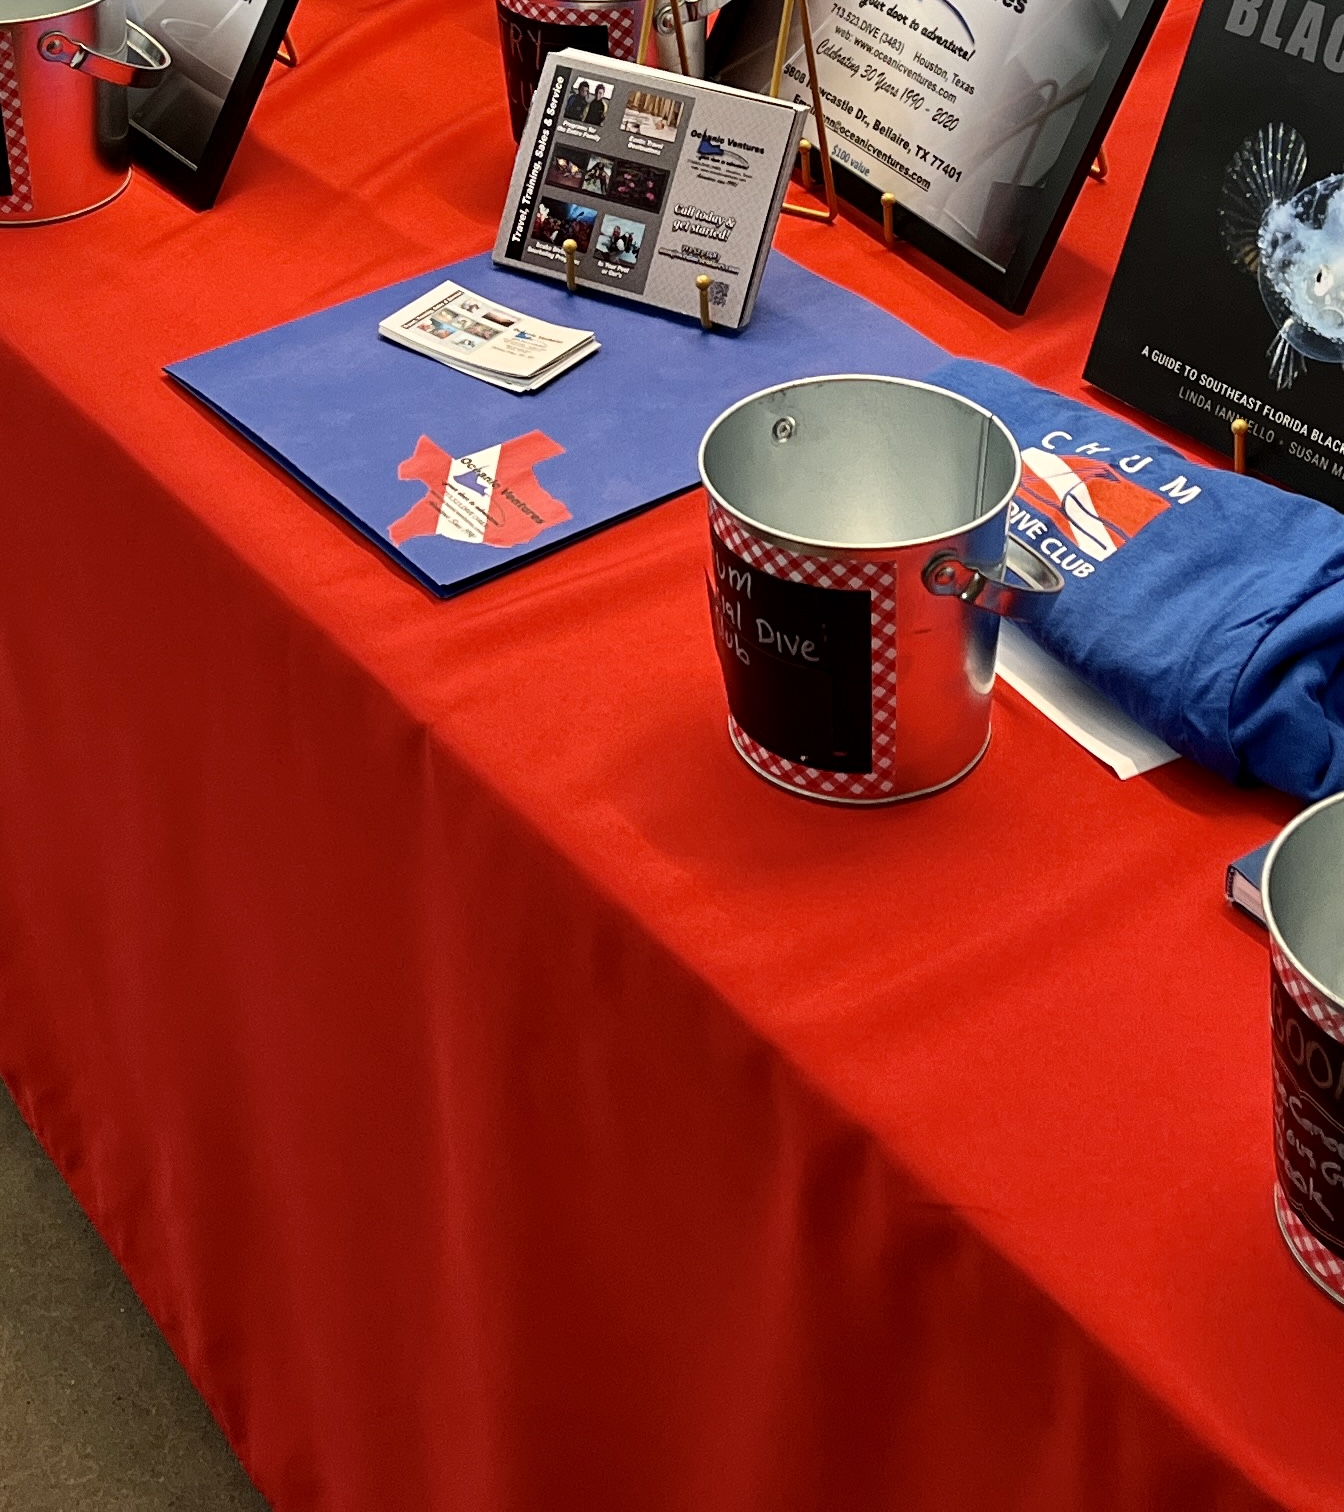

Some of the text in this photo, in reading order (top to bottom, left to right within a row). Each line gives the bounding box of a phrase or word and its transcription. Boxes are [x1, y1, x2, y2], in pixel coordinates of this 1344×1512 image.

[831, 3, 975, 96] 713.523.DIVE (3483) Houston, Texas
[909, 16, 920, 31] to
[816, 39, 960, 133] Celebrating 30 Years 1990 2020
[853, 36, 957, 104] www.oceanicventures.com
[511, 75, 565, 243] Travel, Training, Sales & Service
[783, 63, 806, 84] 5808
[806, 77, 854, 115] wcastle
[872, 118, 912, 155] Bellaire,
[914, 144, 929, 163] TX
[929, 152, 963, 183] 77401
[831, 143, 870, 177] $100 value
[672, 219, 732, 242] get started!
[674, 203, 736, 229] Call today &
[1141, 345, 1150, 357] A
[1151, 349, 1181, 373] GUIDE
[1184, 365, 1197, 381] TO
[1199, 374, 1262, 413] SOUTHEAST
[1262, 404, 1308, 436] FLORIDA
[1178, 386, 1212, 412] LINDA
[1214, 403, 1275, 443] IANELLO
[1288, 441, 1329, 472] SUSAN
[1040, 538, 1095, 579] CLUB
